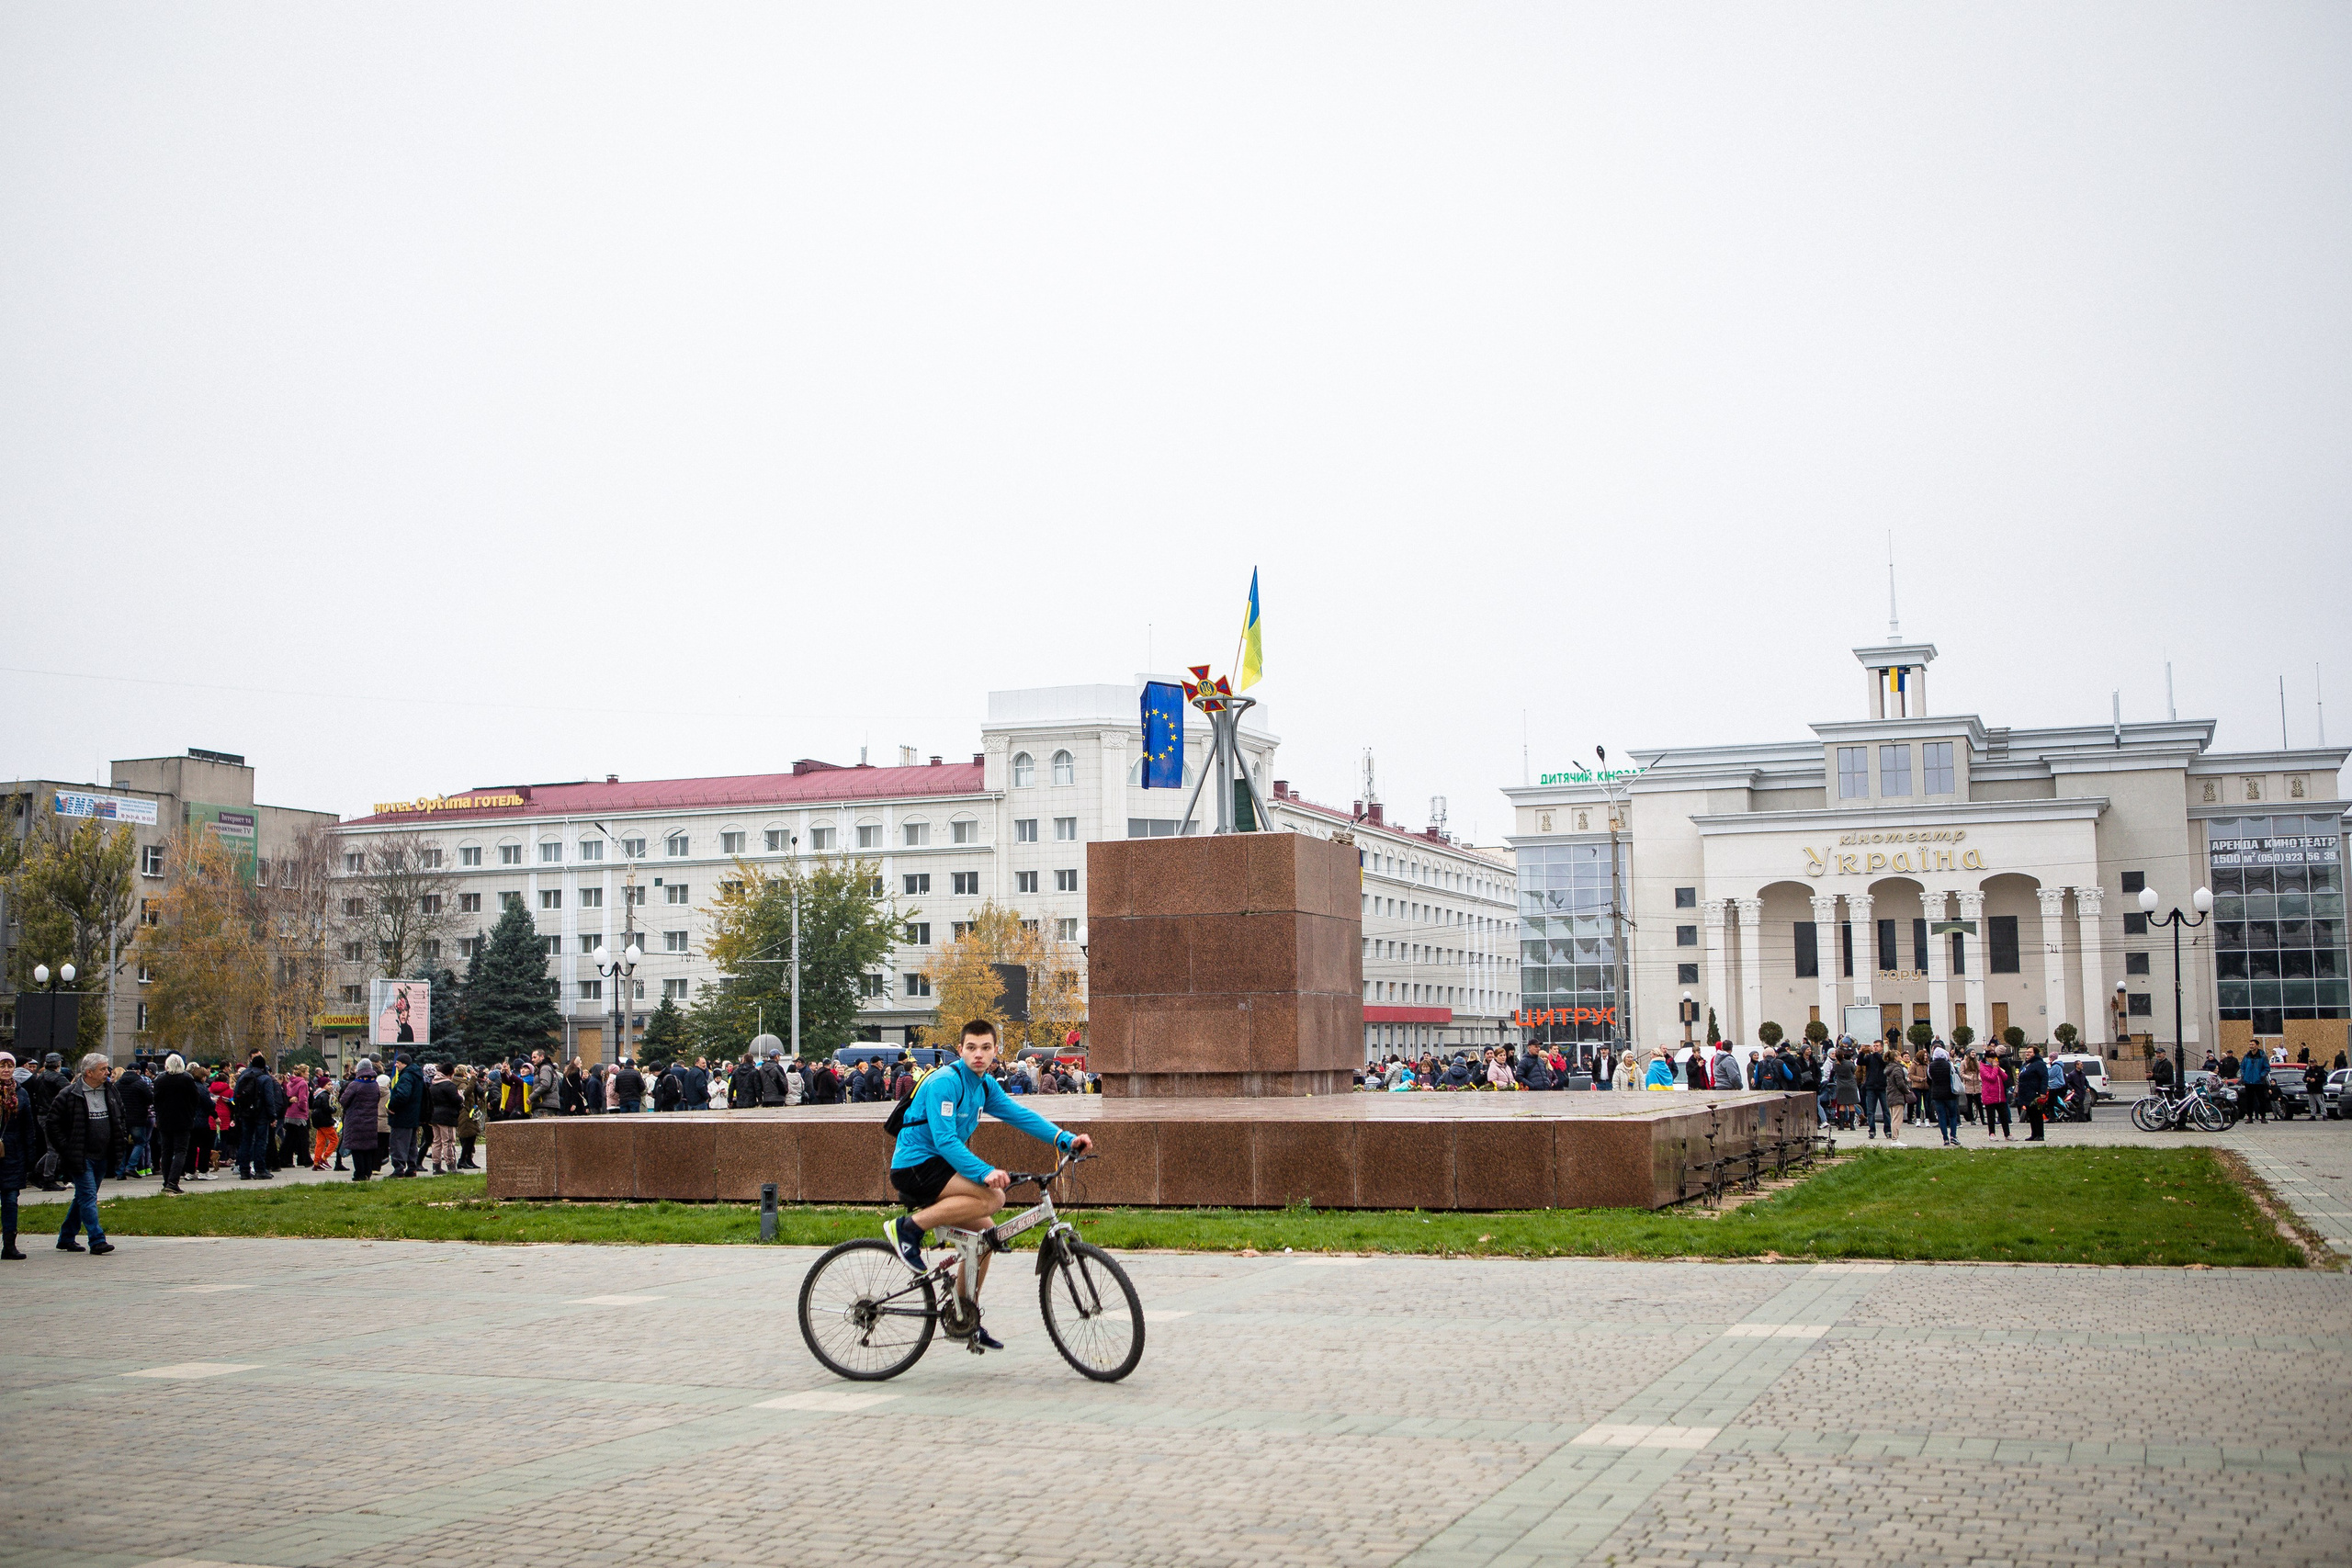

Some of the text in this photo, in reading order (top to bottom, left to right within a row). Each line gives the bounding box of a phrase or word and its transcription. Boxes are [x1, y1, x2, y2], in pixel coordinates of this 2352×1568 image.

[1540, 769, 1592, 784] ДИТЯЧИЙ
[373, 794, 525, 814] HOTEL Optima ГОТЕЛЬ
[1838, 829, 1967, 845] кінотеатр
[2211, 837, 2337, 851] АРЕНДА КИНОТЕАТР
[1802, 844, 1989, 877] Україна
[2212, 854, 2241, 864] 1500
[1515, 1007, 1616, 1029] ЦИТРУС
